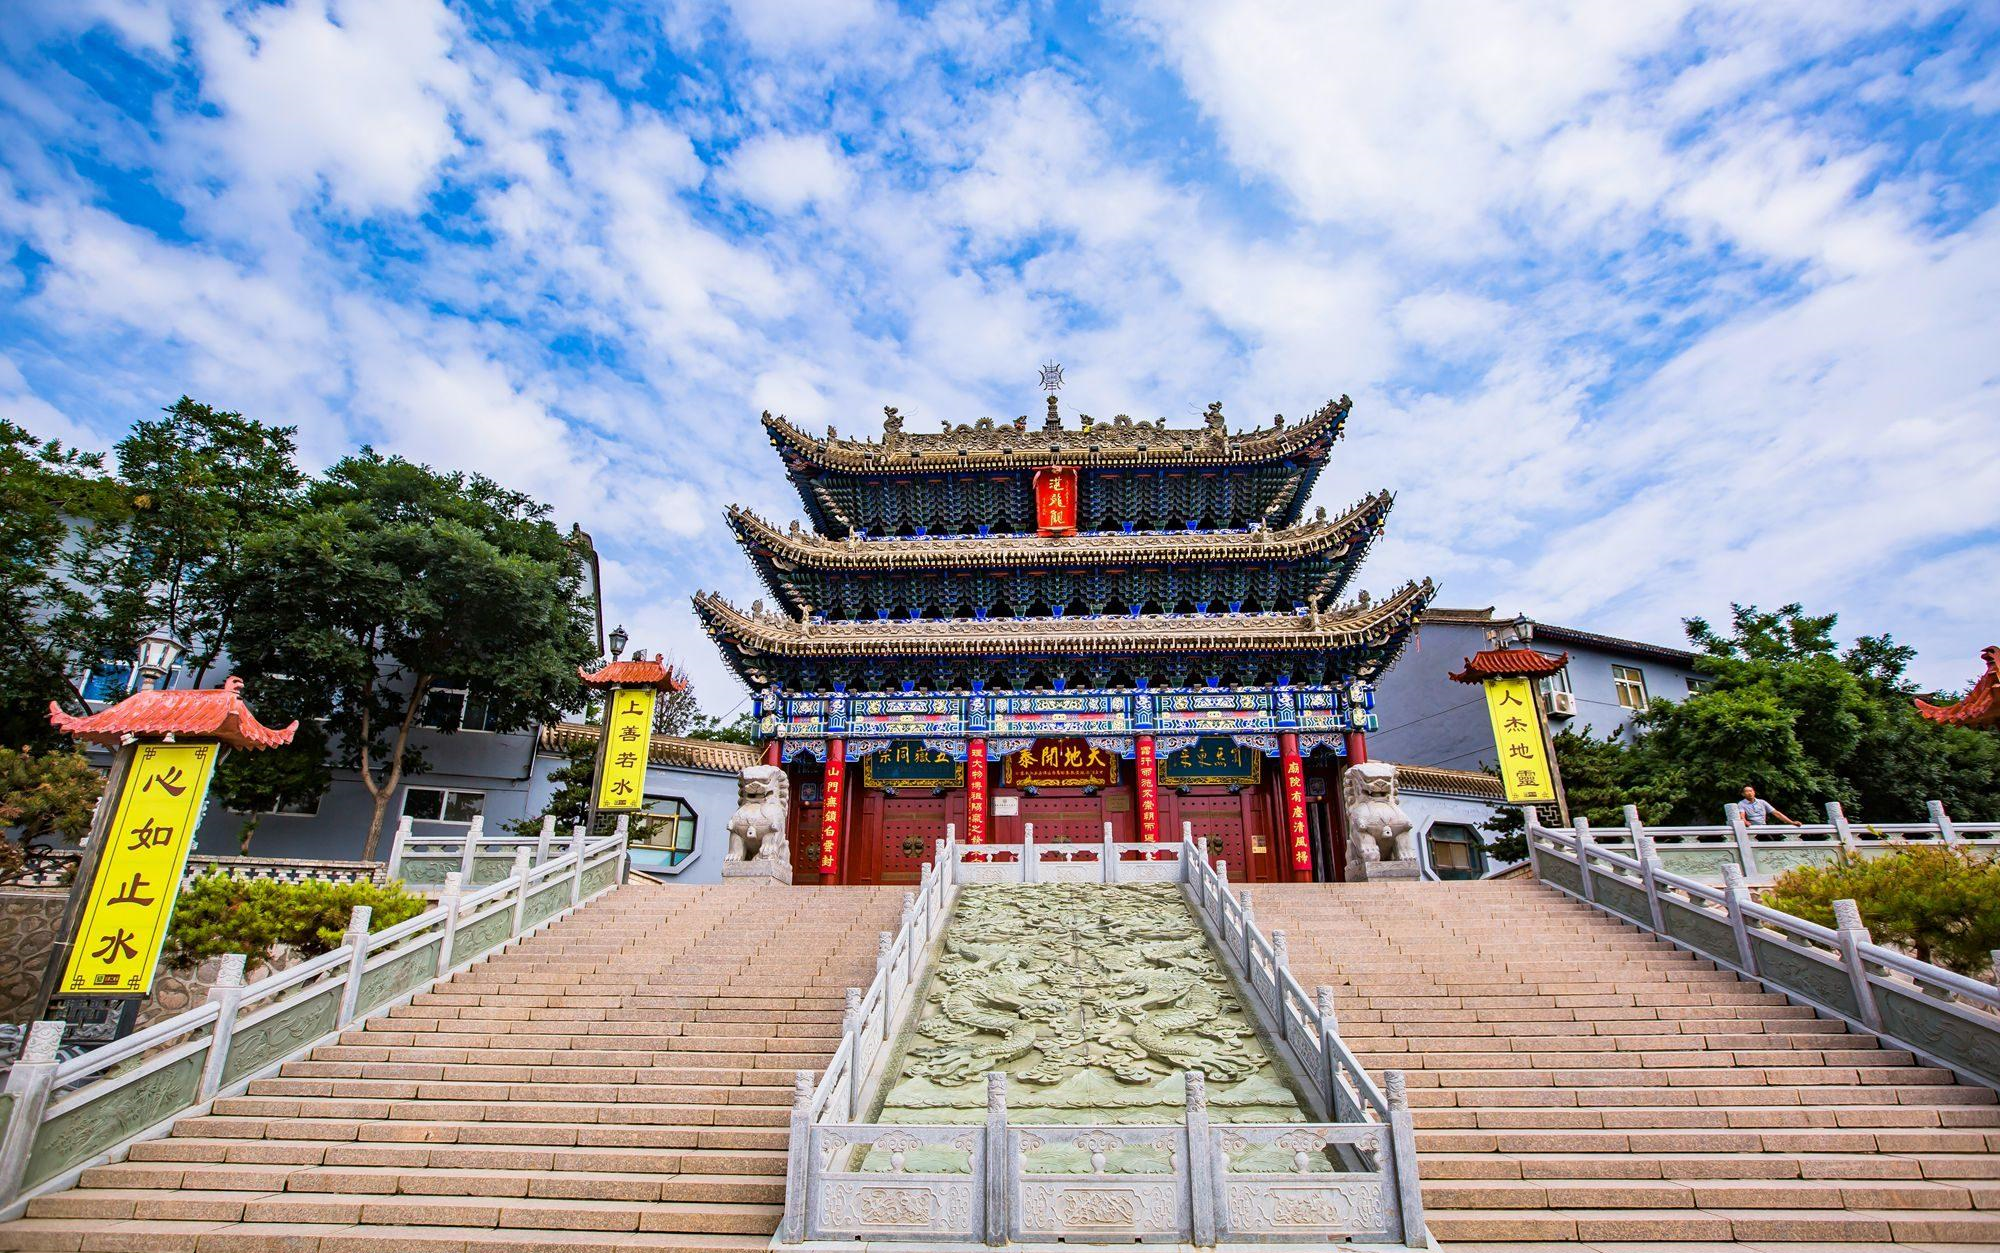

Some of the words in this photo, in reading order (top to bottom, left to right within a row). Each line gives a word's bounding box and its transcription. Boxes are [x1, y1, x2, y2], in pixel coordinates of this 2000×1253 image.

[610, 700, 644, 796] 上善若水
[1499, 689, 1540, 788] 人杰地靈
[91, 765, 188, 965] 心如止水
